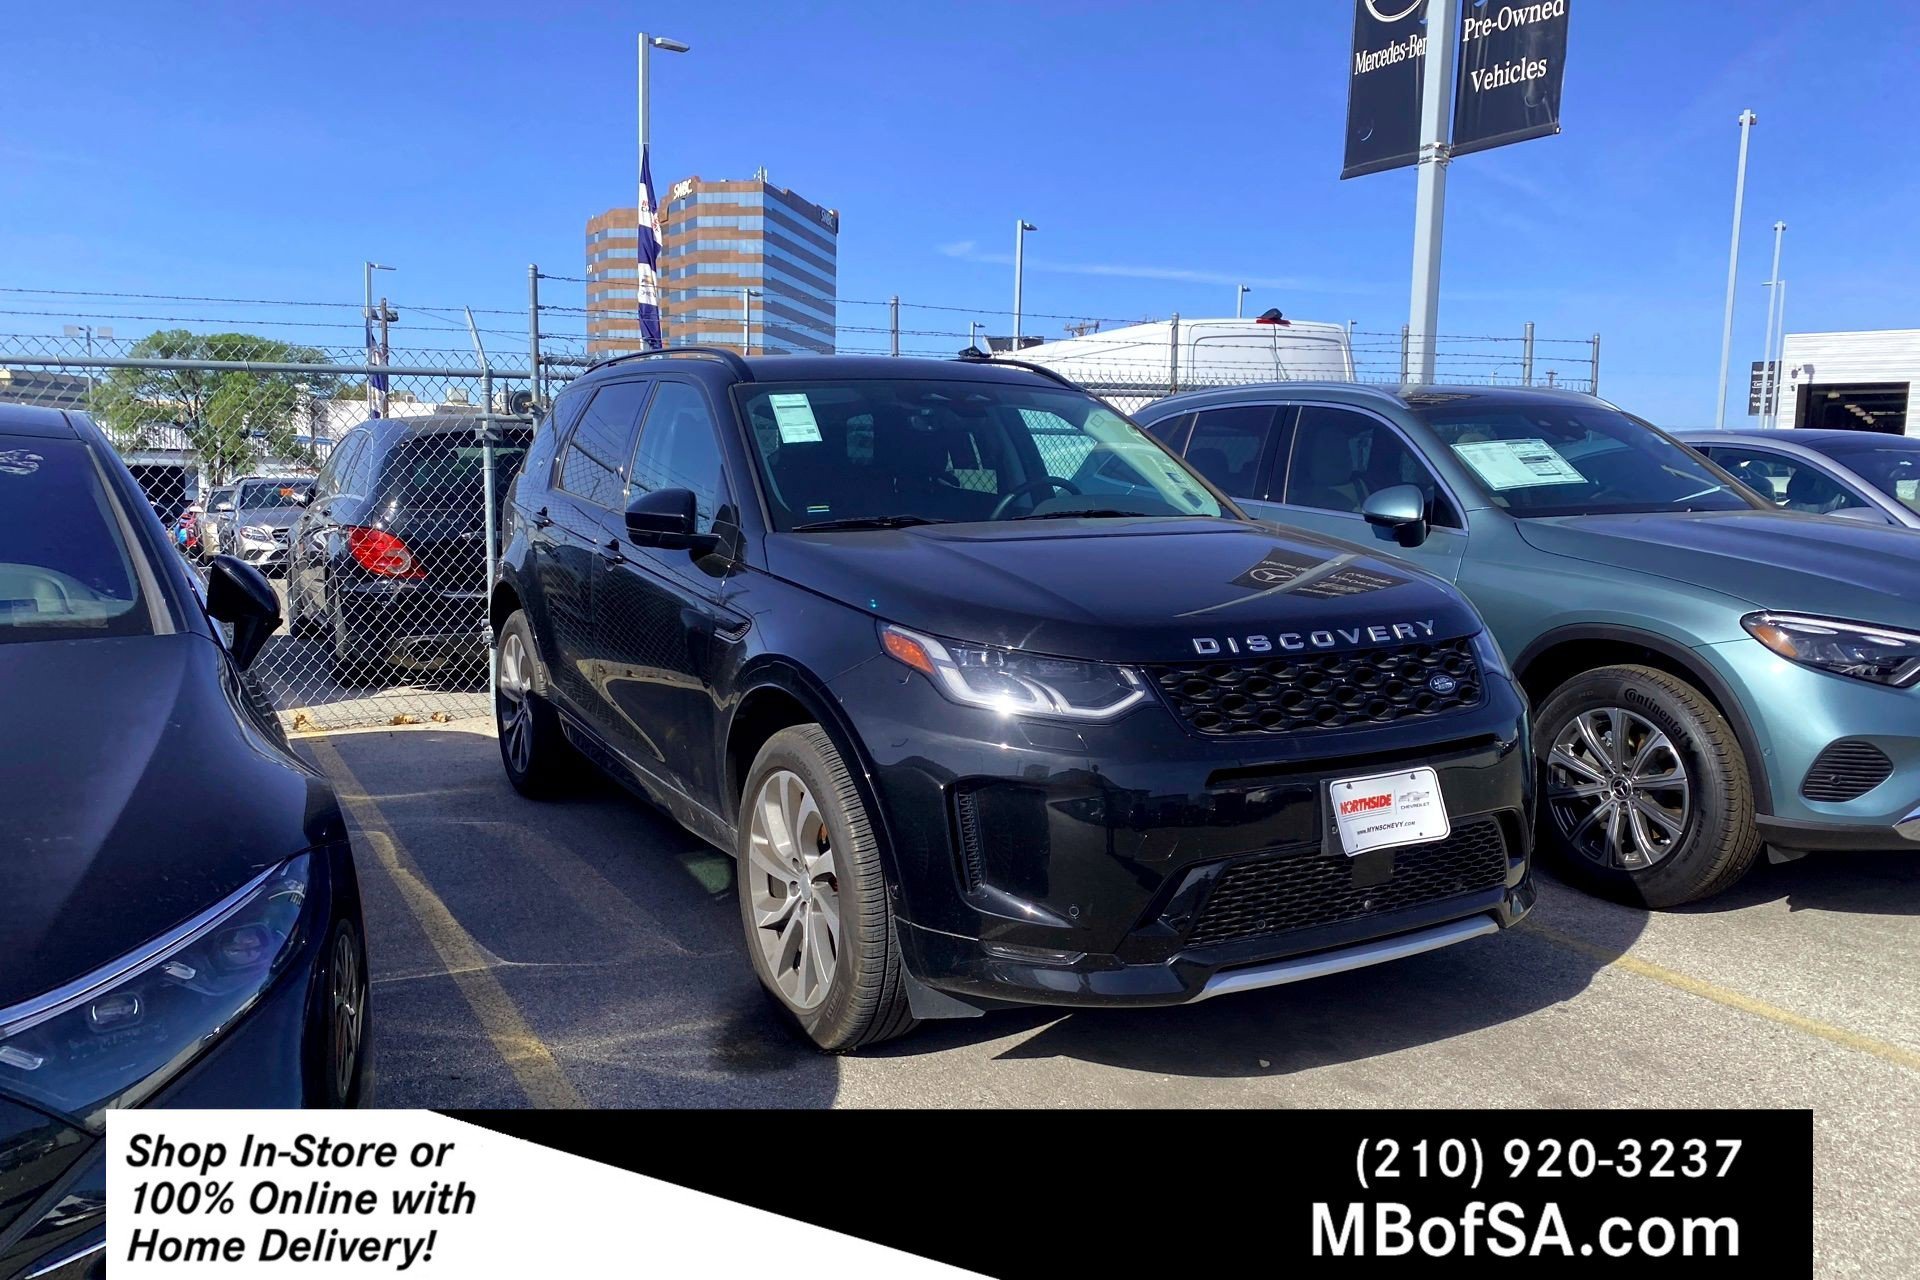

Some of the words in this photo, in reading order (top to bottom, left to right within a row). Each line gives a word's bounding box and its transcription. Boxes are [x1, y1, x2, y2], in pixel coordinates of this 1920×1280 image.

[1462, 0, 1565, 42] Pre-Owned
[1354, 34, 1428, 75] Mercedes-Be
[1471, 58, 1548, 92] Vehicles
[1192, 619, 1435, 654] DISCOVERY
[1624, 688, 1688, 740] Continental
[1340, 793, 1392, 815] NORTHSIDE
